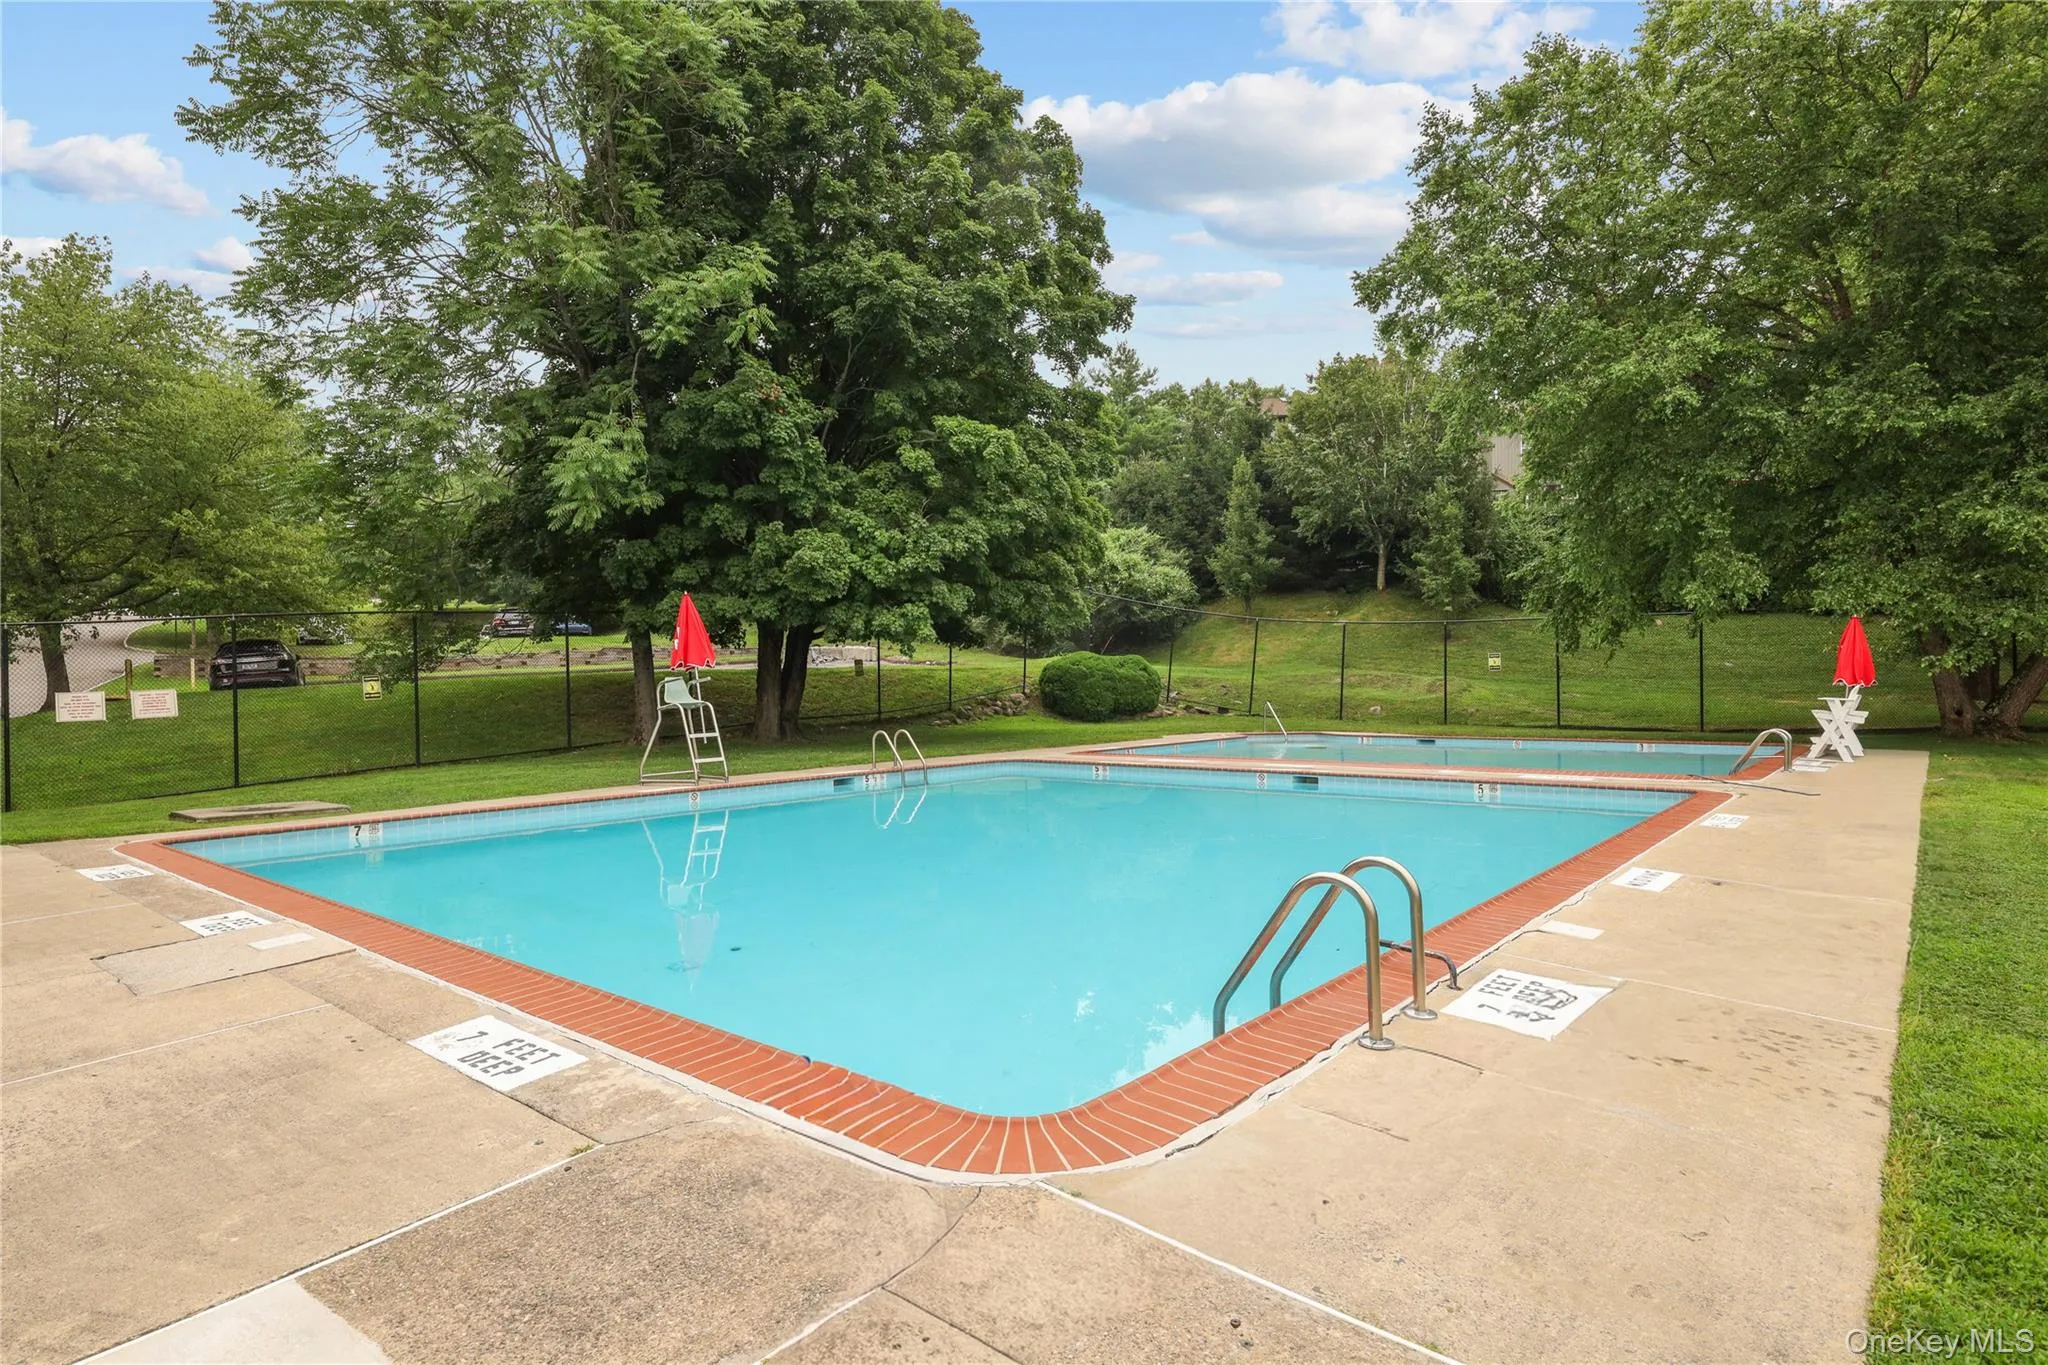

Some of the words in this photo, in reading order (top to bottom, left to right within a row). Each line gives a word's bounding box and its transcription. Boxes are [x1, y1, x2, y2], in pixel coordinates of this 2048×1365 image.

[1478, 783, 1484, 794] 5
[354, 825, 362, 836] 7
[1478, 974, 1522, 997] FEET
[1477, 1003, 1502, 1013] 7
[456, 1030, 489, 1042] 7
[491, 1037, 561, 1065] FEET
[456, 1049, 525, 1077] DEEP
